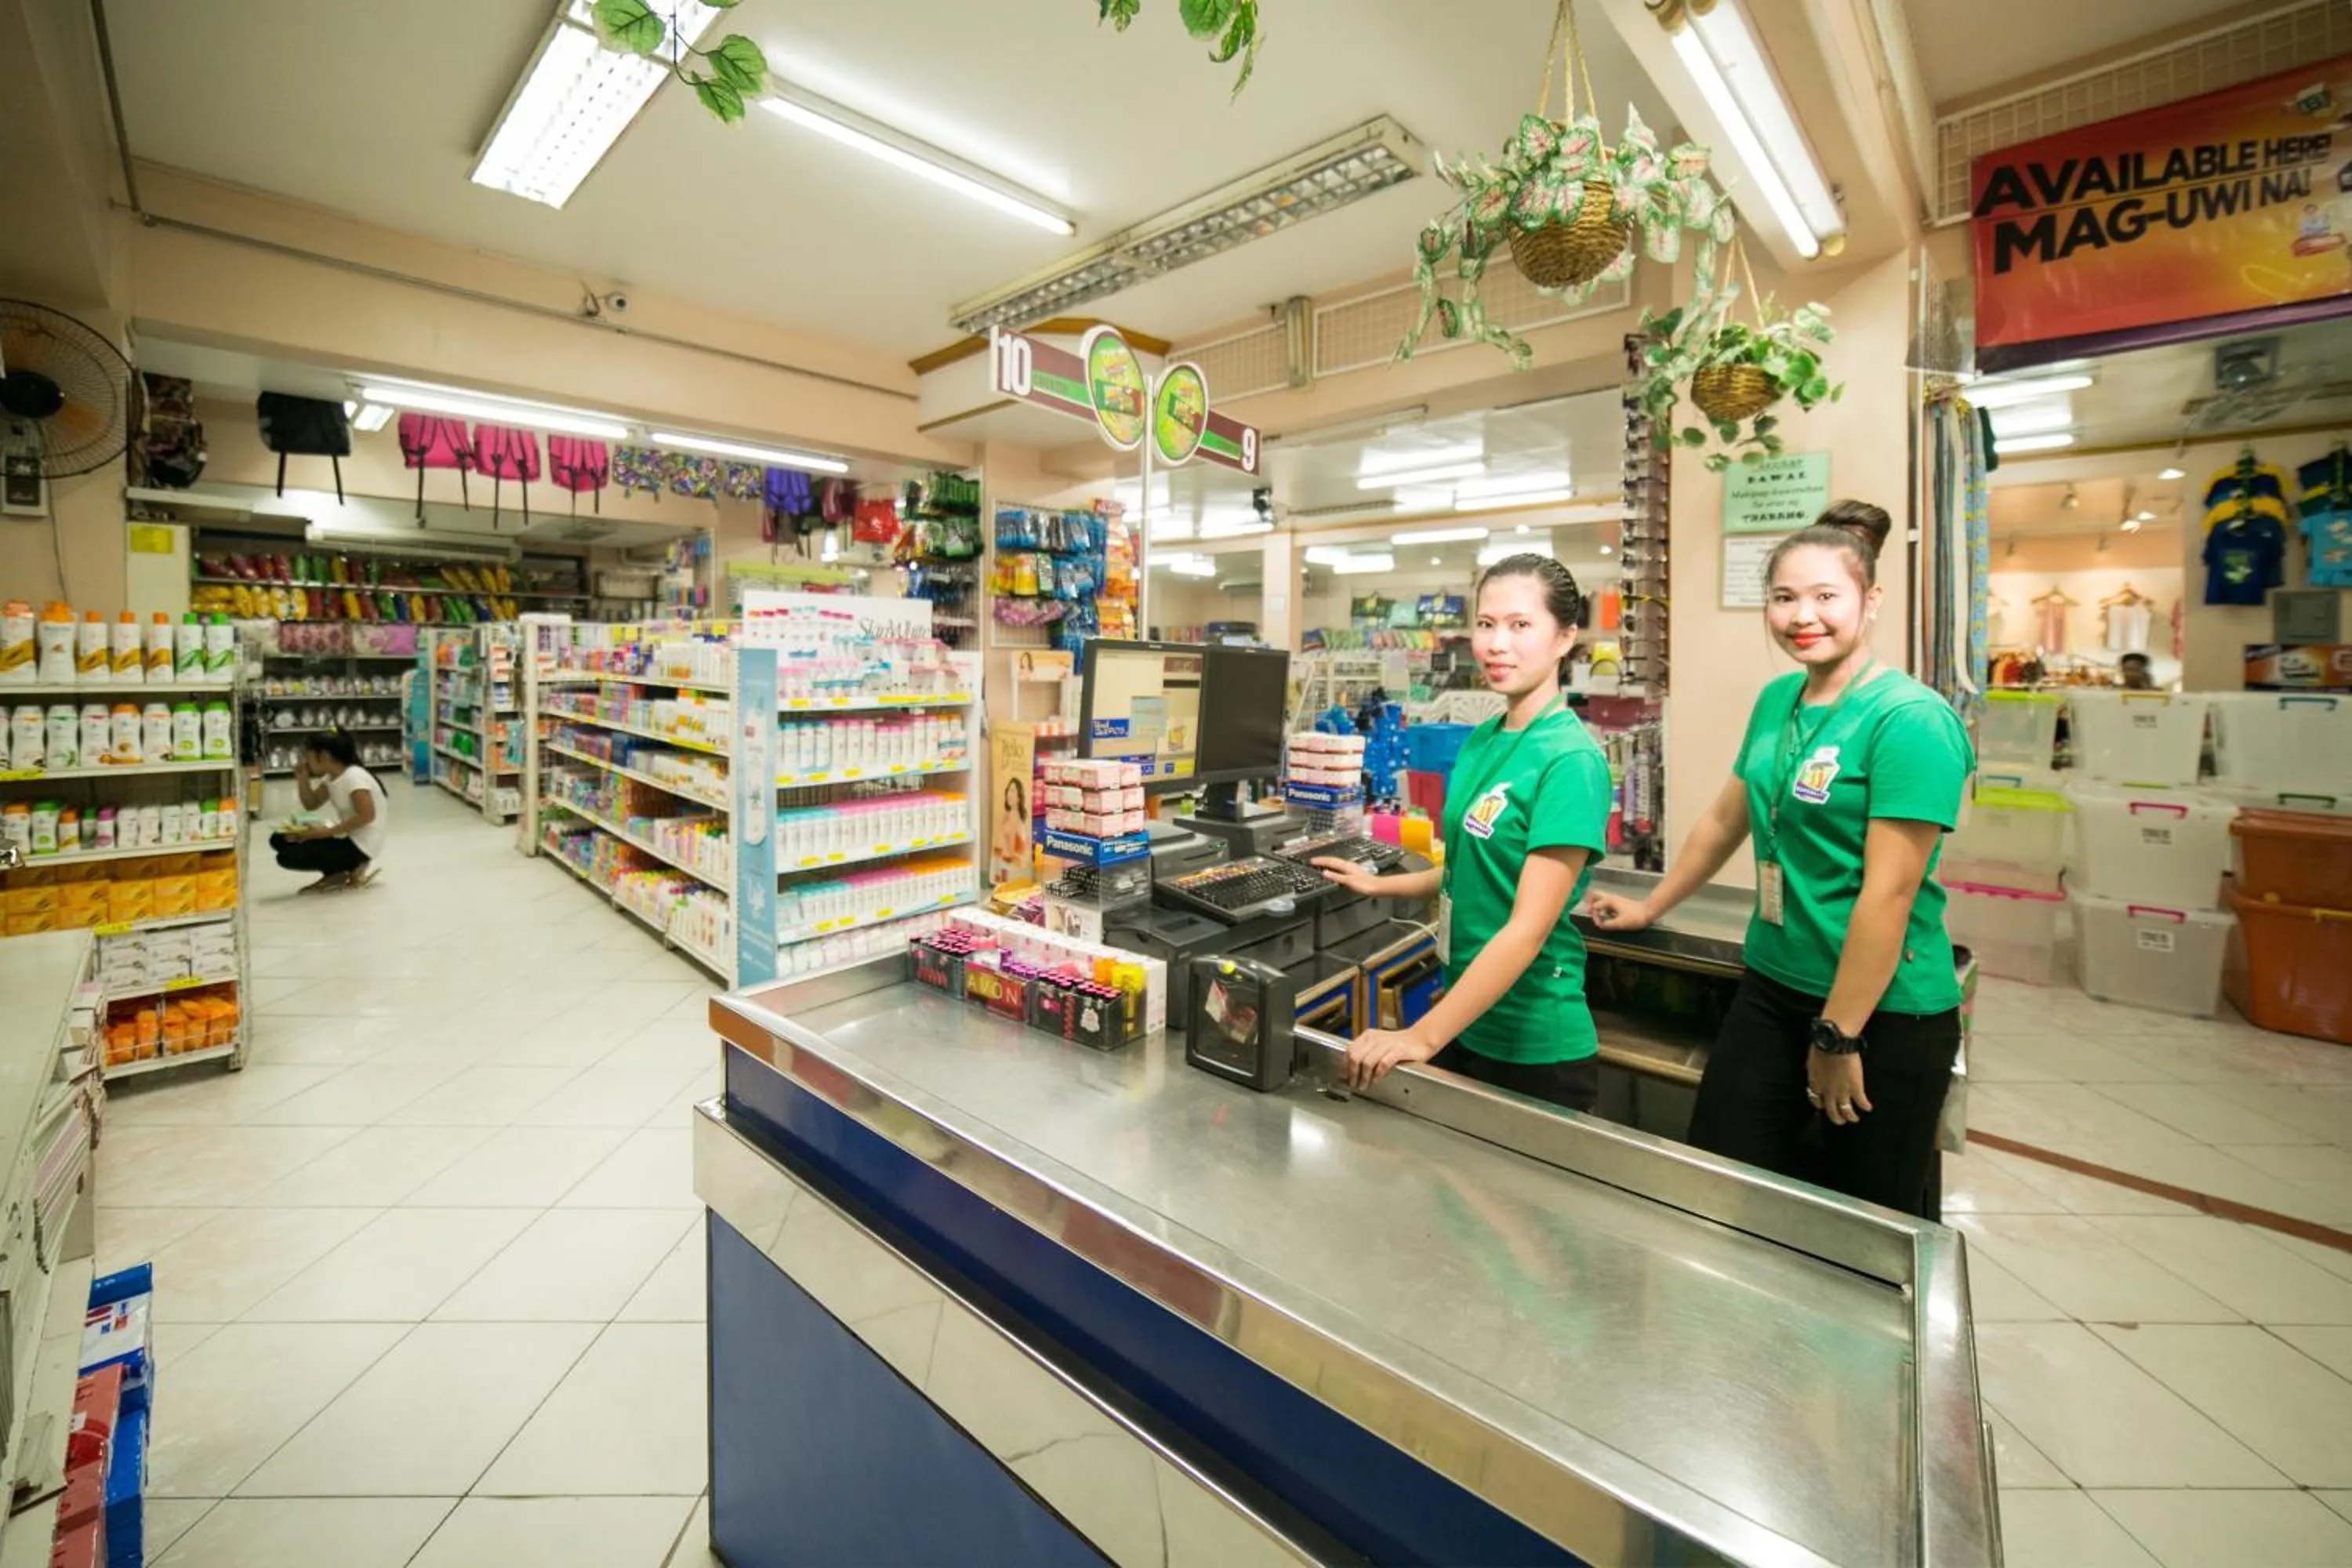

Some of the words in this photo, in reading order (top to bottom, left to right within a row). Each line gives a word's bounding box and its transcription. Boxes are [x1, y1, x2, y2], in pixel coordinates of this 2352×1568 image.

[1973, 143, 2256, 217] AVAILABLE
[1994, 187, 2251, 275] MAG-UWI
[2259, 168, 2311, 207] NA!
[998, 333, 1033, 396] 10
[1241, 427, 1257, 472] 9
[1046, 835, 1094, 857] Panasonic
[967, 972, 1018, 1005] AVON
